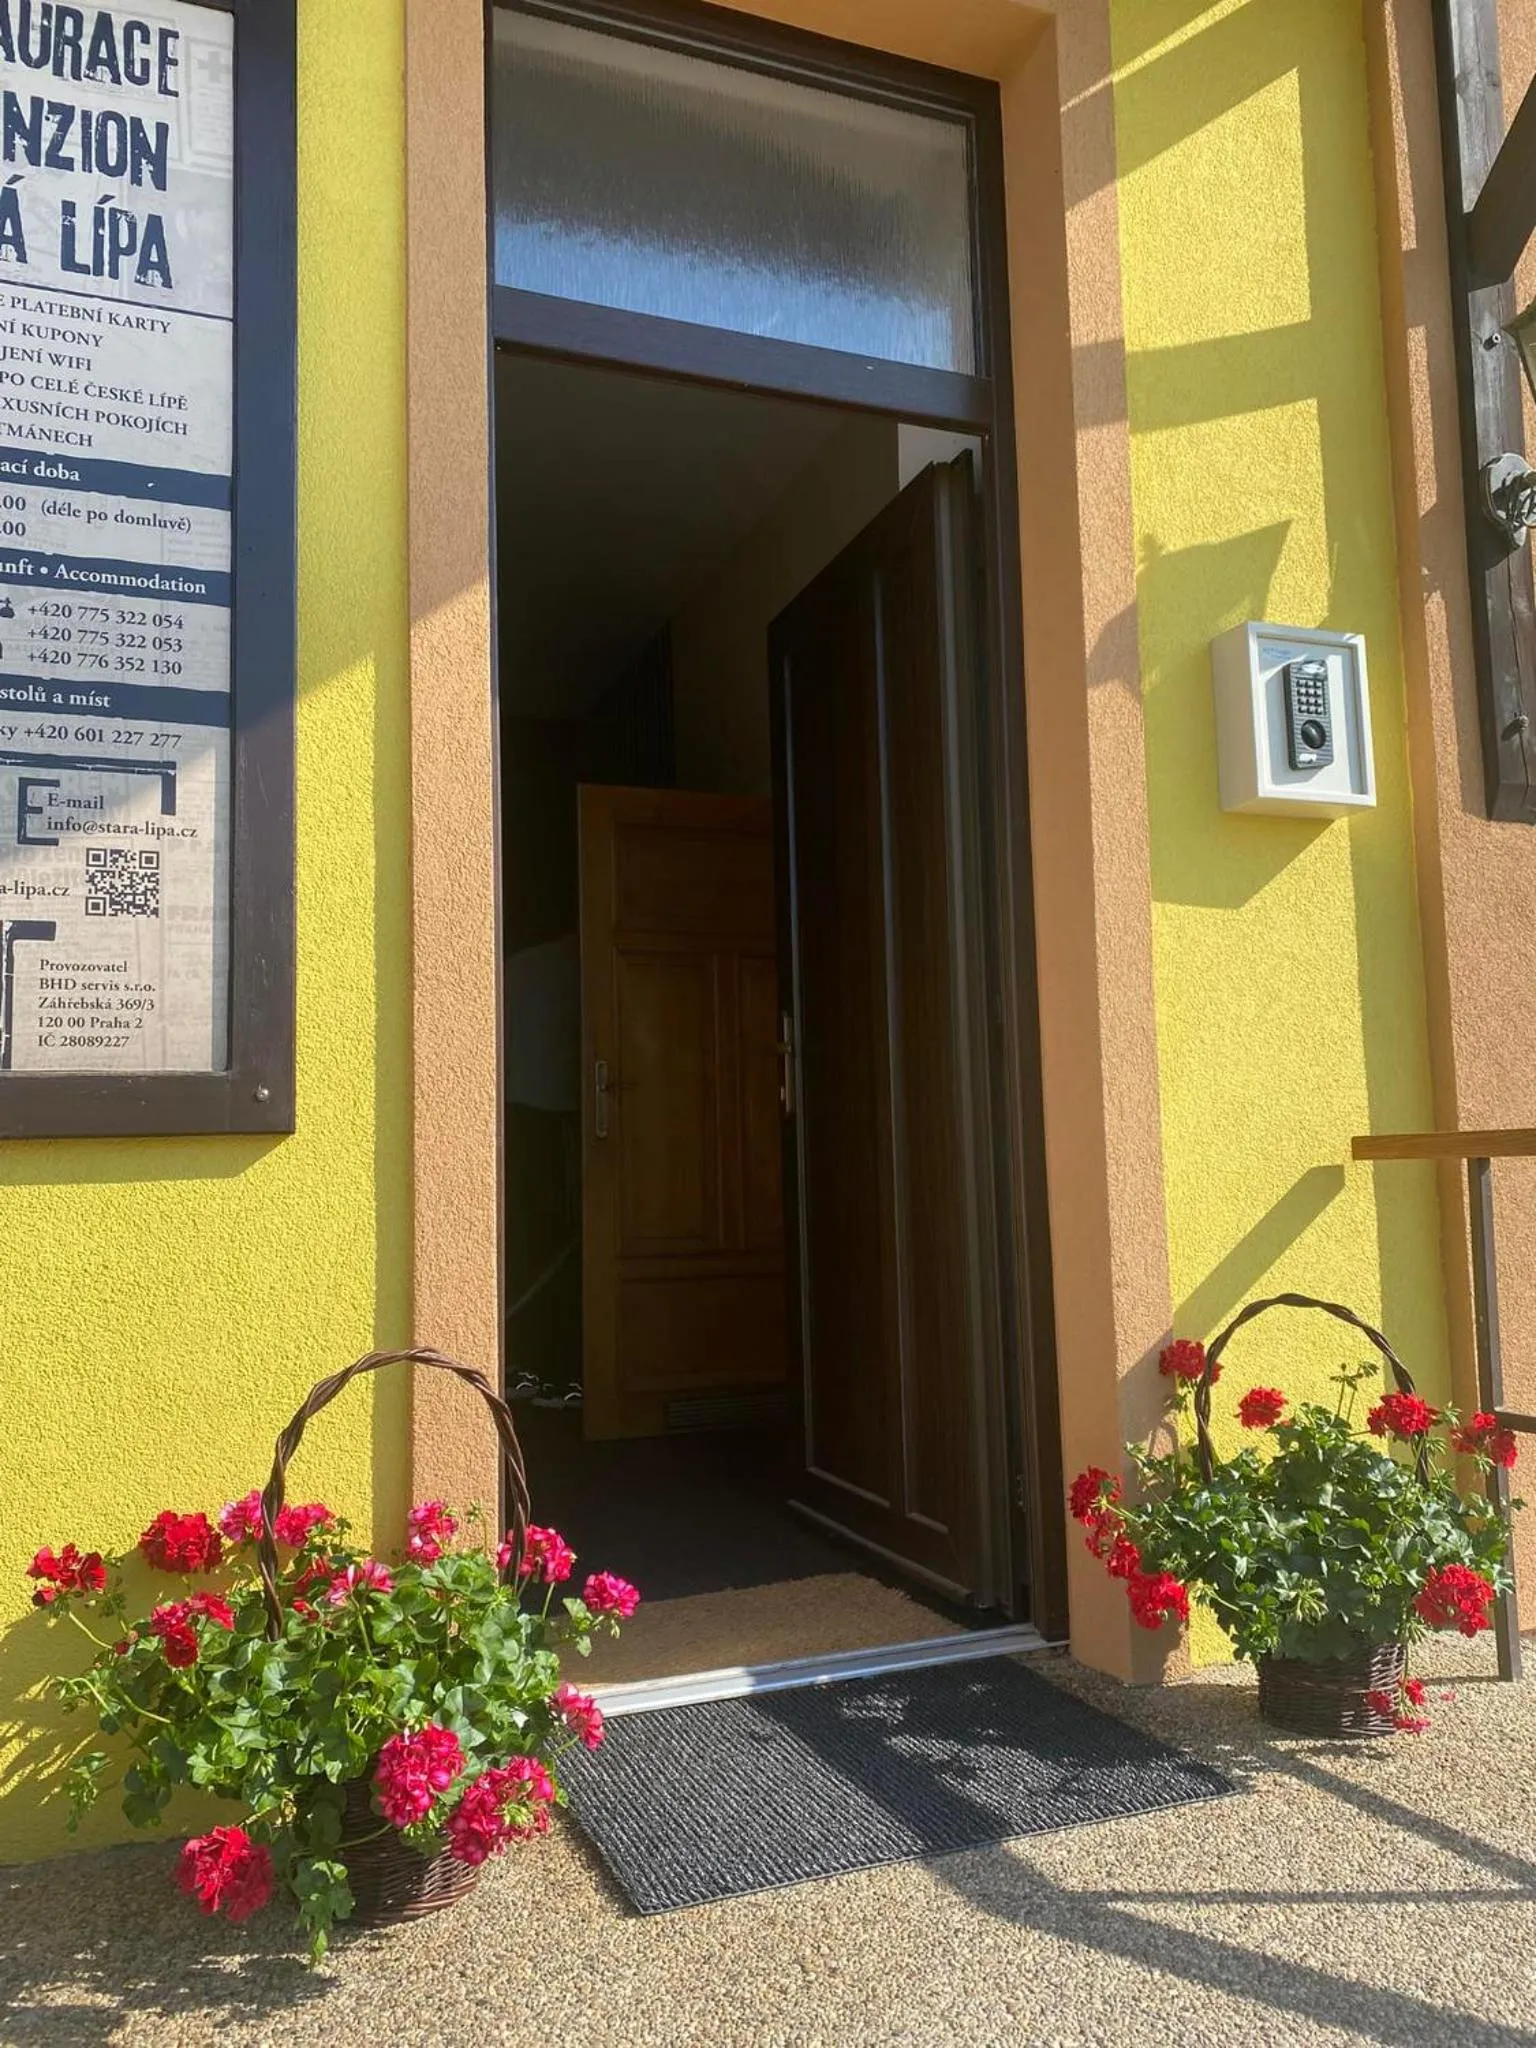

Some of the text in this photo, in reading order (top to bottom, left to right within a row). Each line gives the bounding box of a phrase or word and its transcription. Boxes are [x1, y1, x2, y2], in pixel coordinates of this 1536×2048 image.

[3, 90, 169, 191] NZION
[61, 194, 173, 289] LÍPA
[11, 296, 103, 323] PLATEBNÍ
[108, 312, 171, 334] KARTY
[22, 323, 103, 347] KUPONY
[48, 353, 92, 371] WIFI
[0, 371, 188, 411] PO CELÉ ČESKÉ LÍPĚ
[2, 397, 188, 436] XUSNÍCH POKOJÍCH
[0, 459, 81, 482] ací doba
[41, 499, 82, 518] (déle
[86, 510, 108, 524] po
[114, 509, 192, 533] domluvě)
[54, 563, 207, 594] Accommodation
[28, 601, 184, 629] +420 775 322 054
[28, 625, 183, 652] +420 775 322 053
[27, 649, 182, 675] +420 776 352 130
[0, 685, 112, 708] stolů a míst
[24, 723, 68, 740] +420
[74, 727, 104, 742] 601
[111, 730, 144, 745] 227
[150, 733, 182, 749] 277
[48, 793, 104, 810] E-mail
[47, 817, 198, 840] info@stara-lipa.cz
[40, 959, 128, 973] Provozovatel
[39, 978, 156, 992] BHD servis s.r.o.
[116, 998, 154, 1011] 369/3
[38, 1016, 143, 1029] 120 00 Praha 2
[38, 1032, 129, 1048] IČ 28089227
